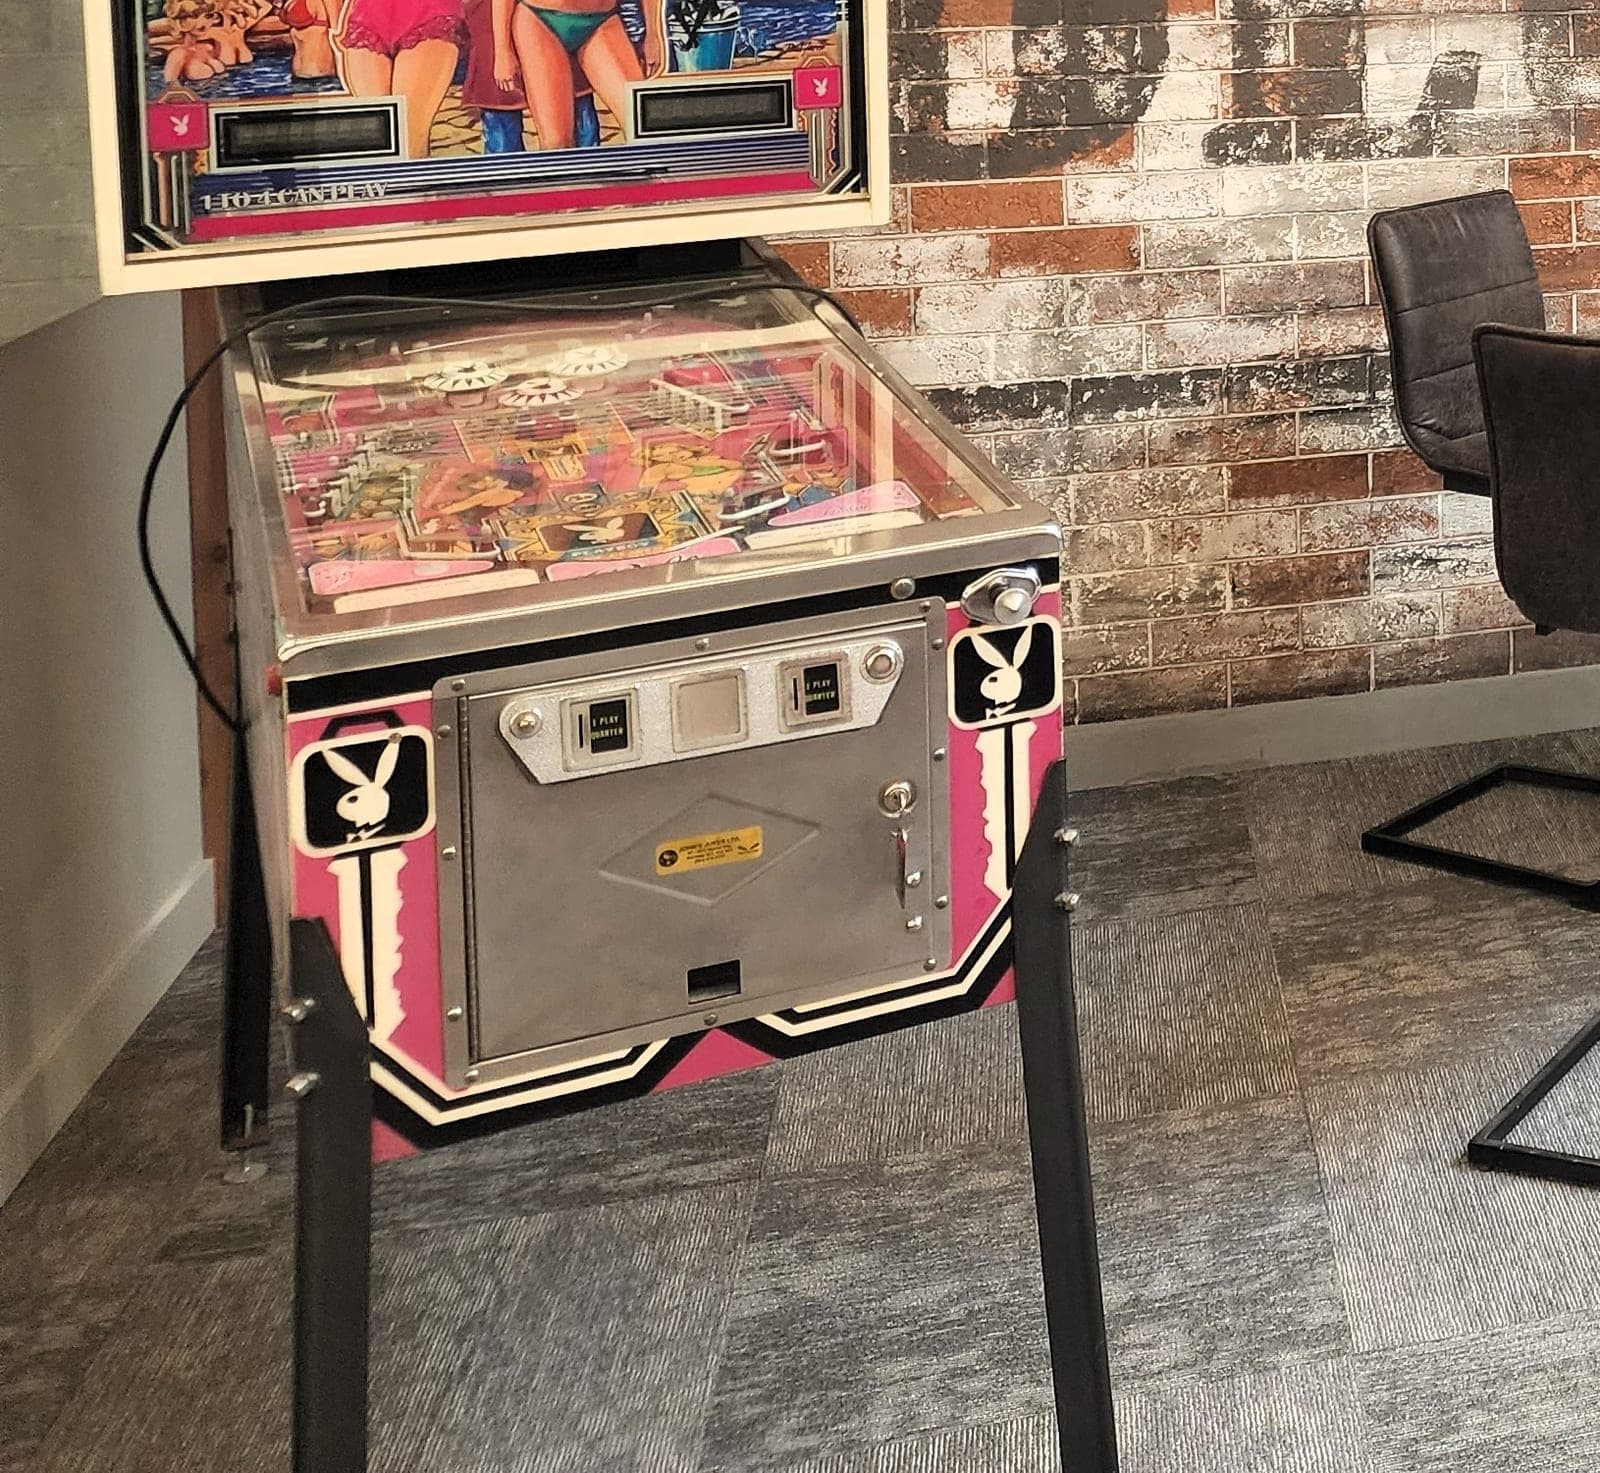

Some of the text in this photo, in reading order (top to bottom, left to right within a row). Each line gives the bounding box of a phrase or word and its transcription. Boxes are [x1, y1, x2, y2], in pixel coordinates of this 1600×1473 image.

[220, 192, 250, 210] TO
[257, 188, 274, 206] 4
[276, 186, 326, 205] CAN
[329, 181, 389, 199] PLAY
[813, 679, 831, 689] PLAY
[599, 715, 619, 726] PLAY
